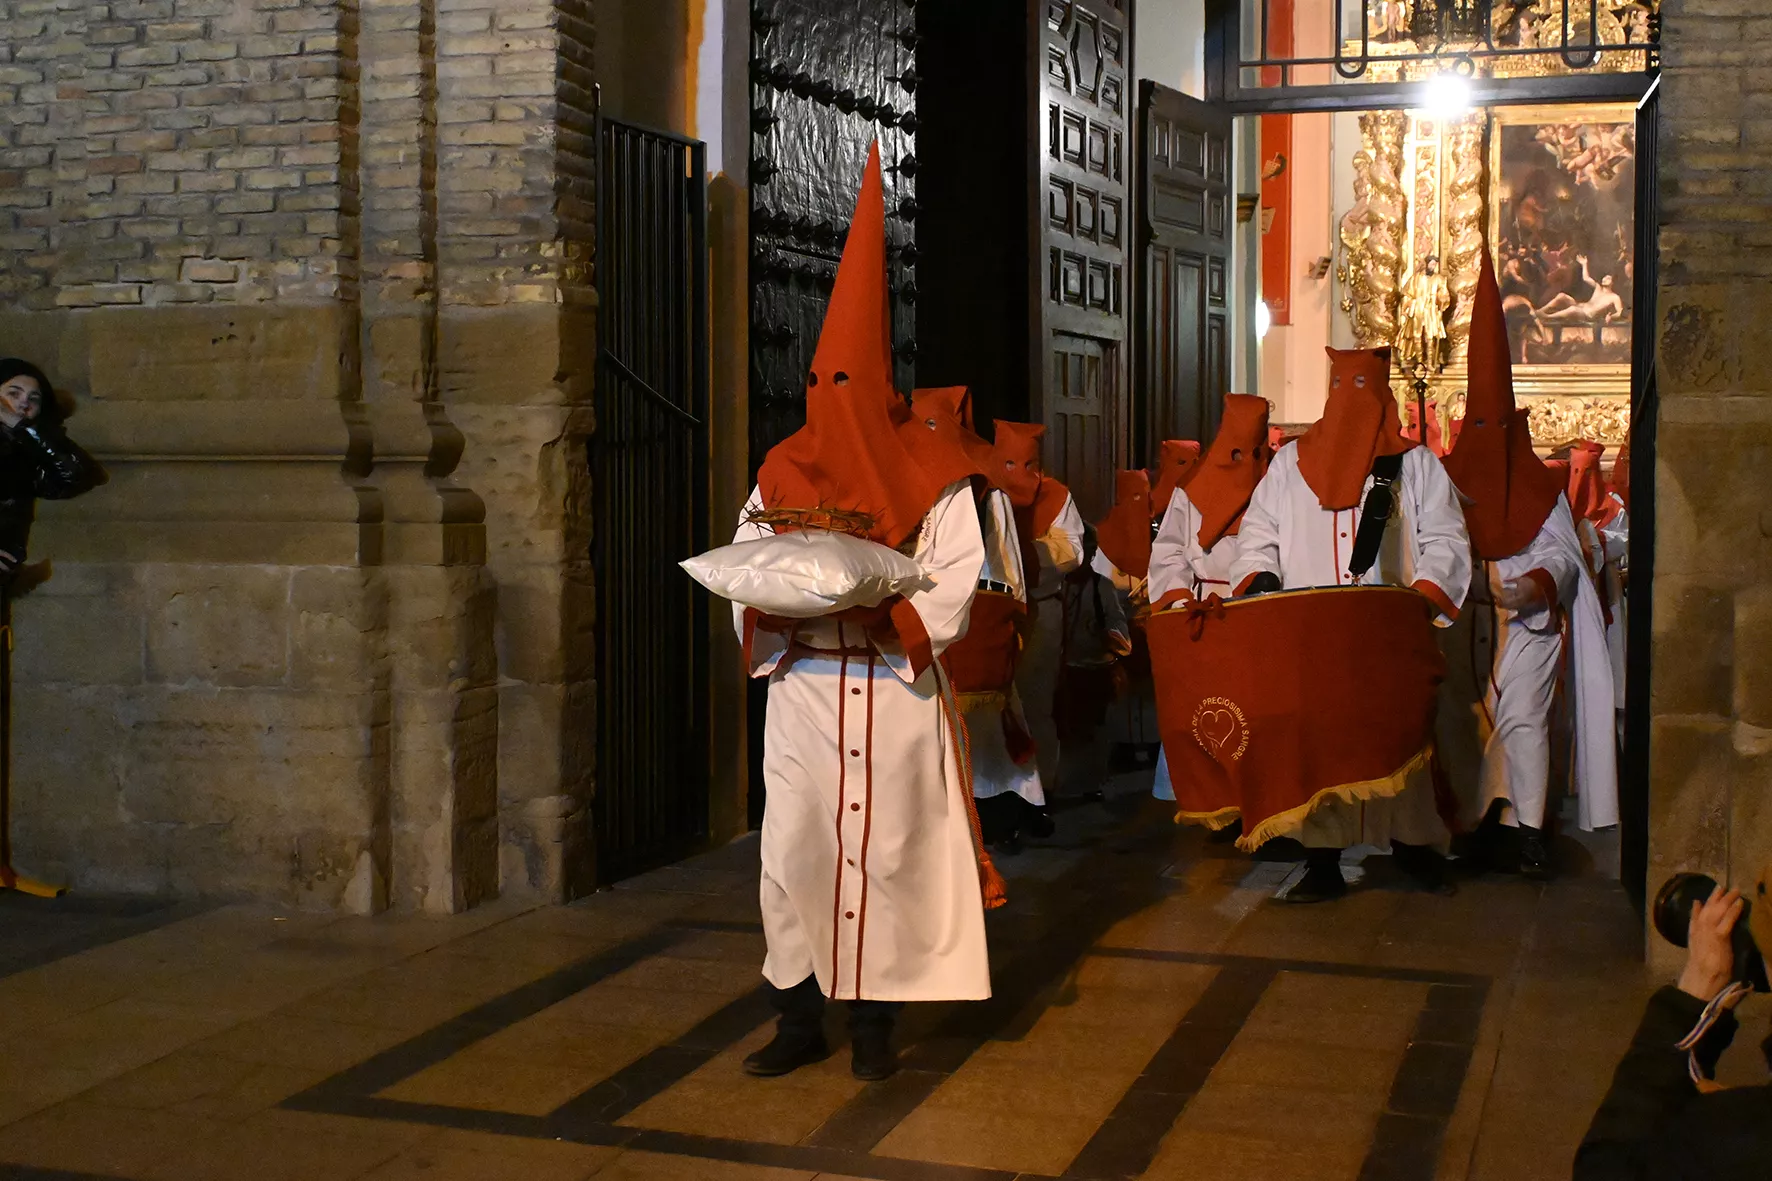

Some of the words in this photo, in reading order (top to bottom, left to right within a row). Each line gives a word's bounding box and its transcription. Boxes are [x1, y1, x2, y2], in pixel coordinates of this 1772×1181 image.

[1191, 715, 1198, 727] DE
[1202, 696, 1248, 727] PRECIOSISIMA
[1230, 729, 1250, 761] SANGRE
